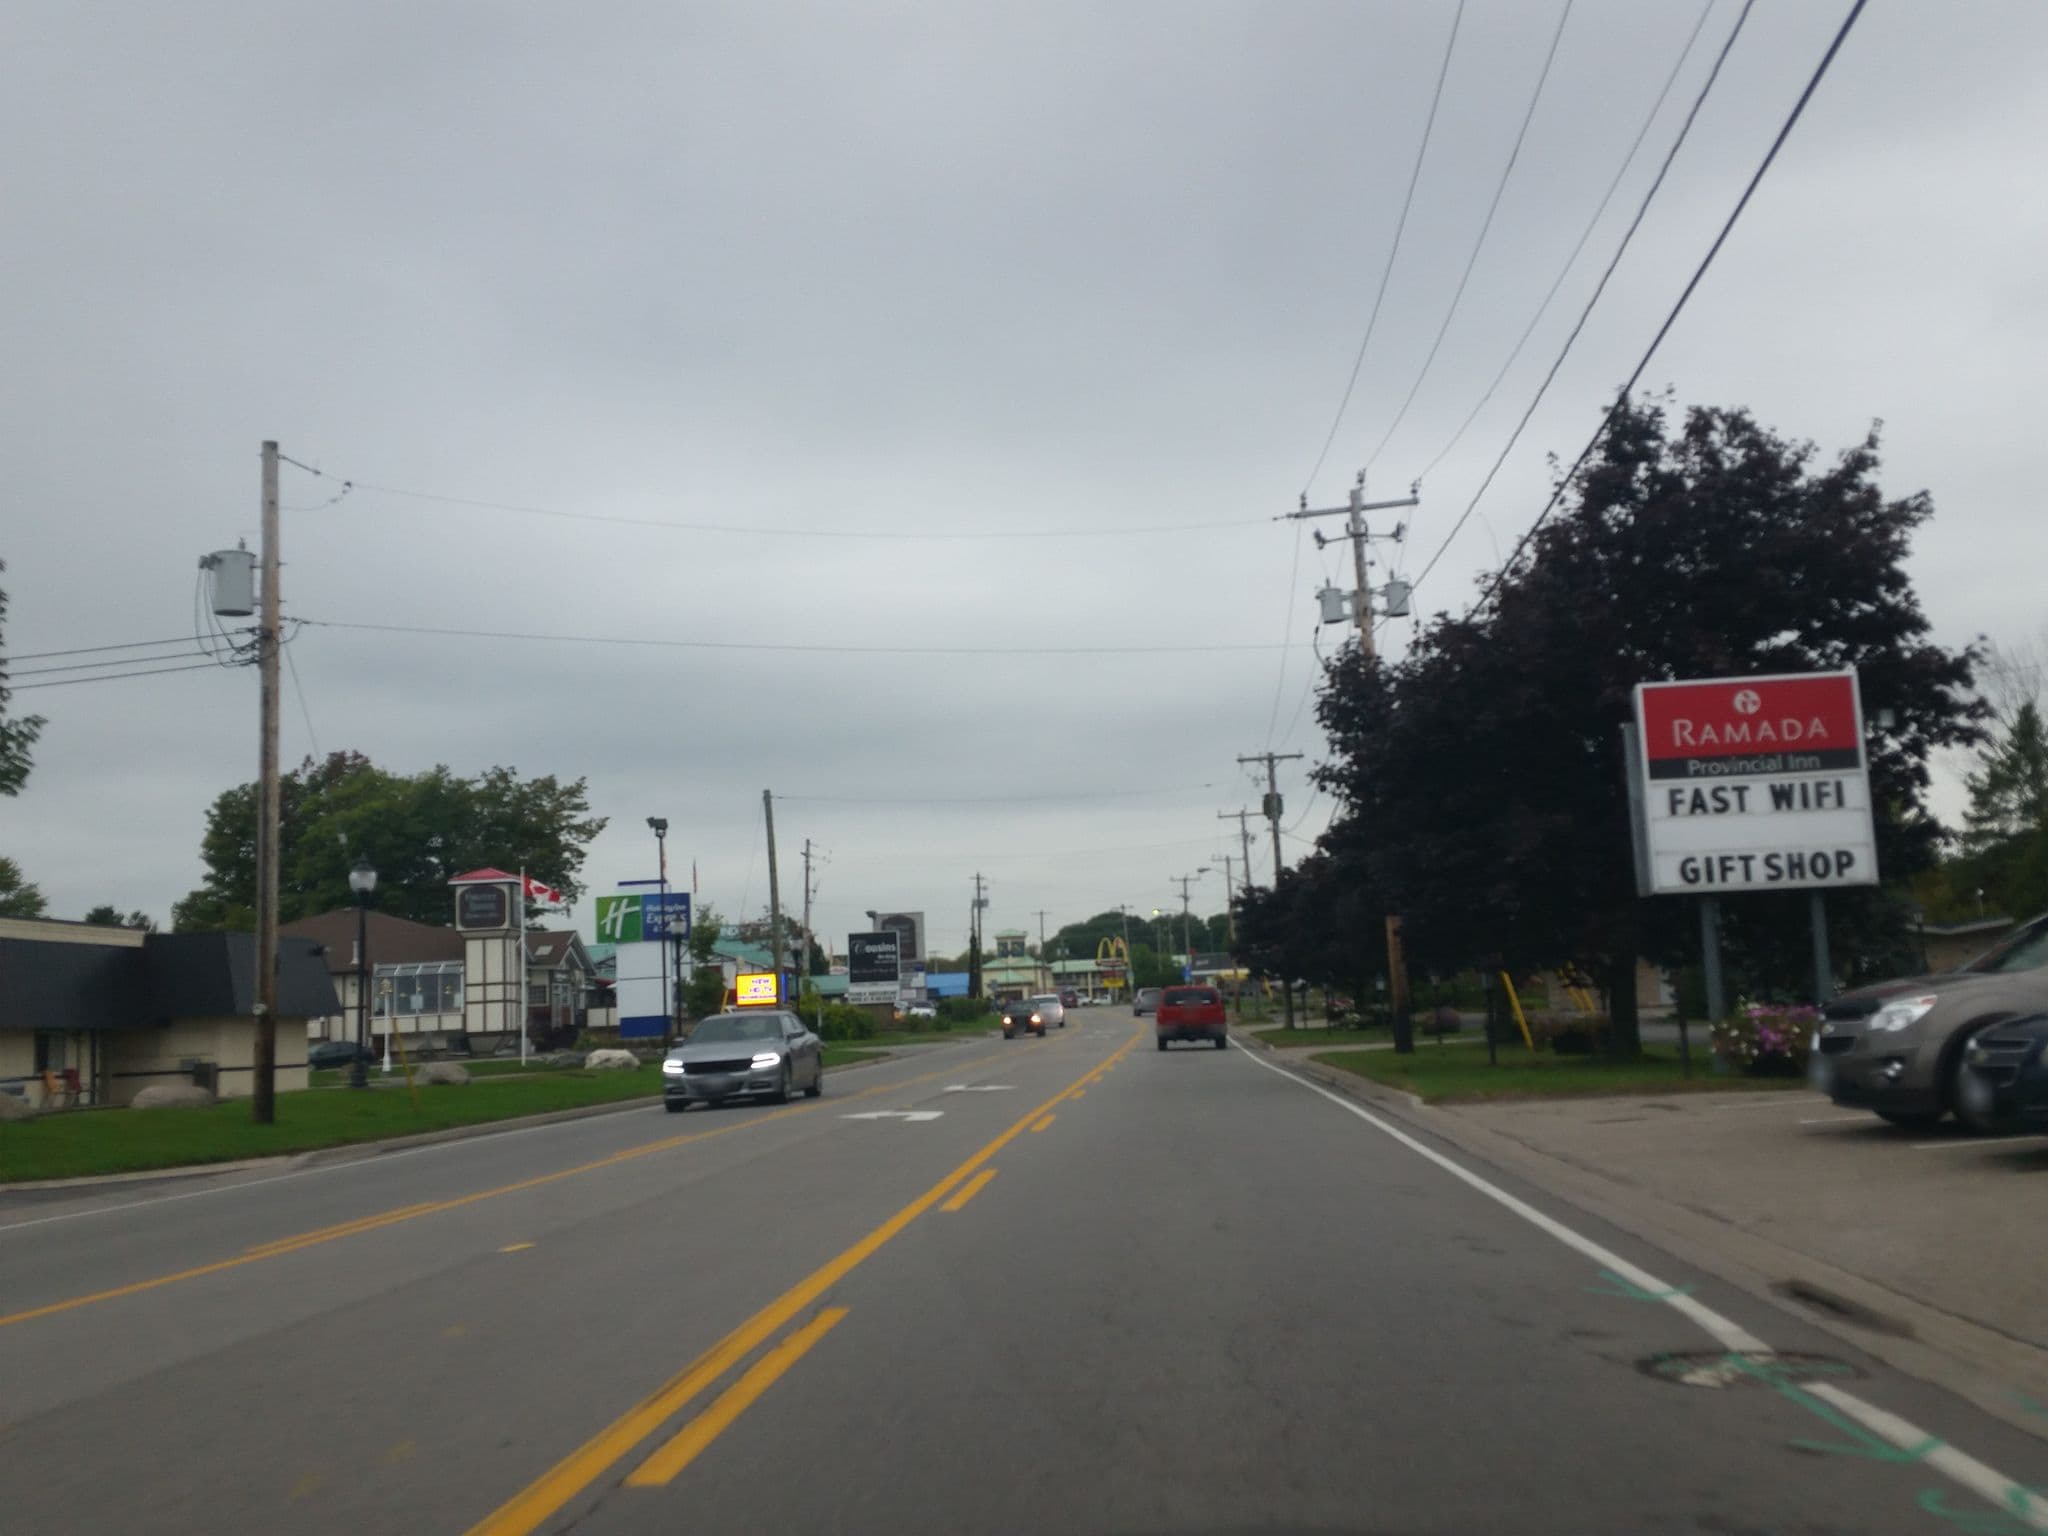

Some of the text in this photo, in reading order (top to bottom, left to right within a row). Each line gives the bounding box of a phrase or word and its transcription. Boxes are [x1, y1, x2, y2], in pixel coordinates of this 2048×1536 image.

[1672, 716, 1828, 747] RAMADA
[1688, 754, 1821, 777] Provincial Inn
[1668, 780, 1845, 816] FAST WIFI
